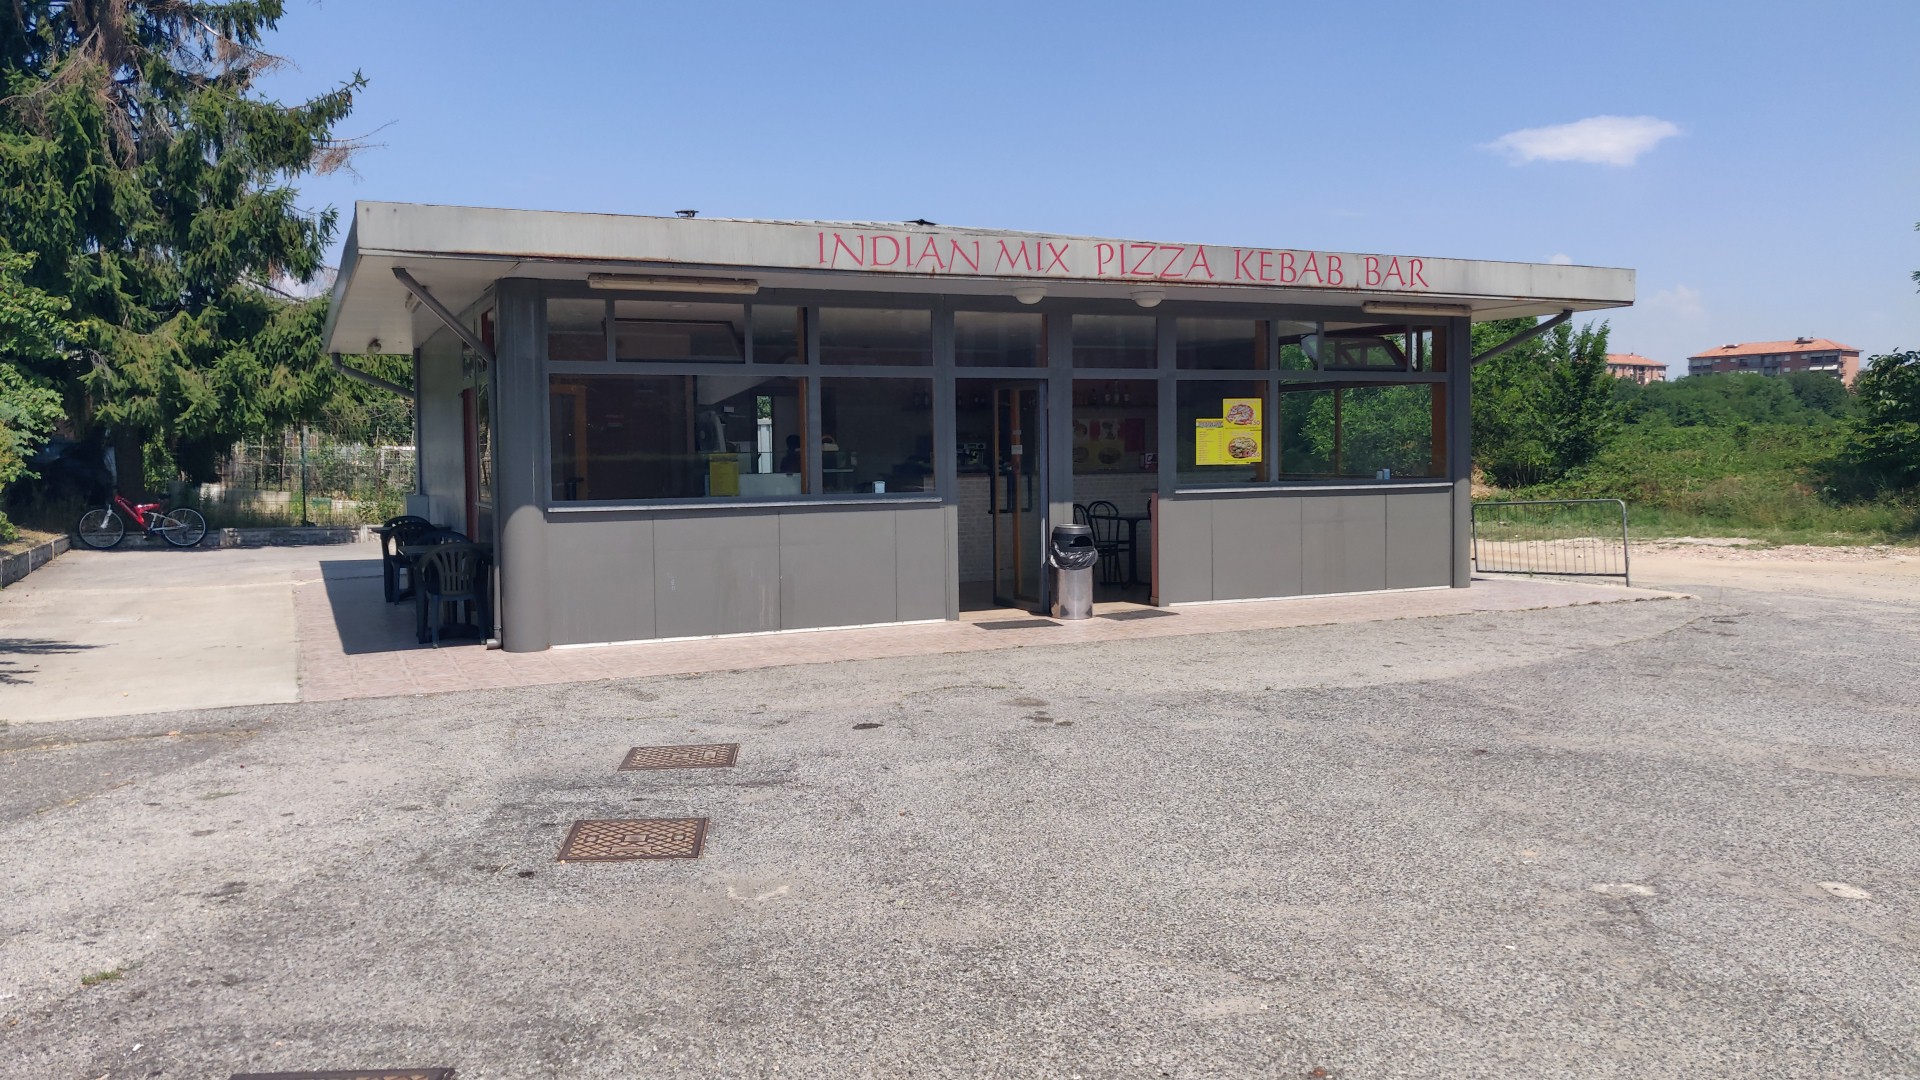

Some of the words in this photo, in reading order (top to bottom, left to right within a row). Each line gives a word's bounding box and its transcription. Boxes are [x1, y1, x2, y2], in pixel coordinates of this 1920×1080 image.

[818, 231, 978, 272] INDIAN
[995, 239, 1071, 272] MIX
[1096, 243, 1214, 279] PIZZA
[1235, 249, 1343, 285] KEBAB
[1365, 256, 1428, 288] BAR
